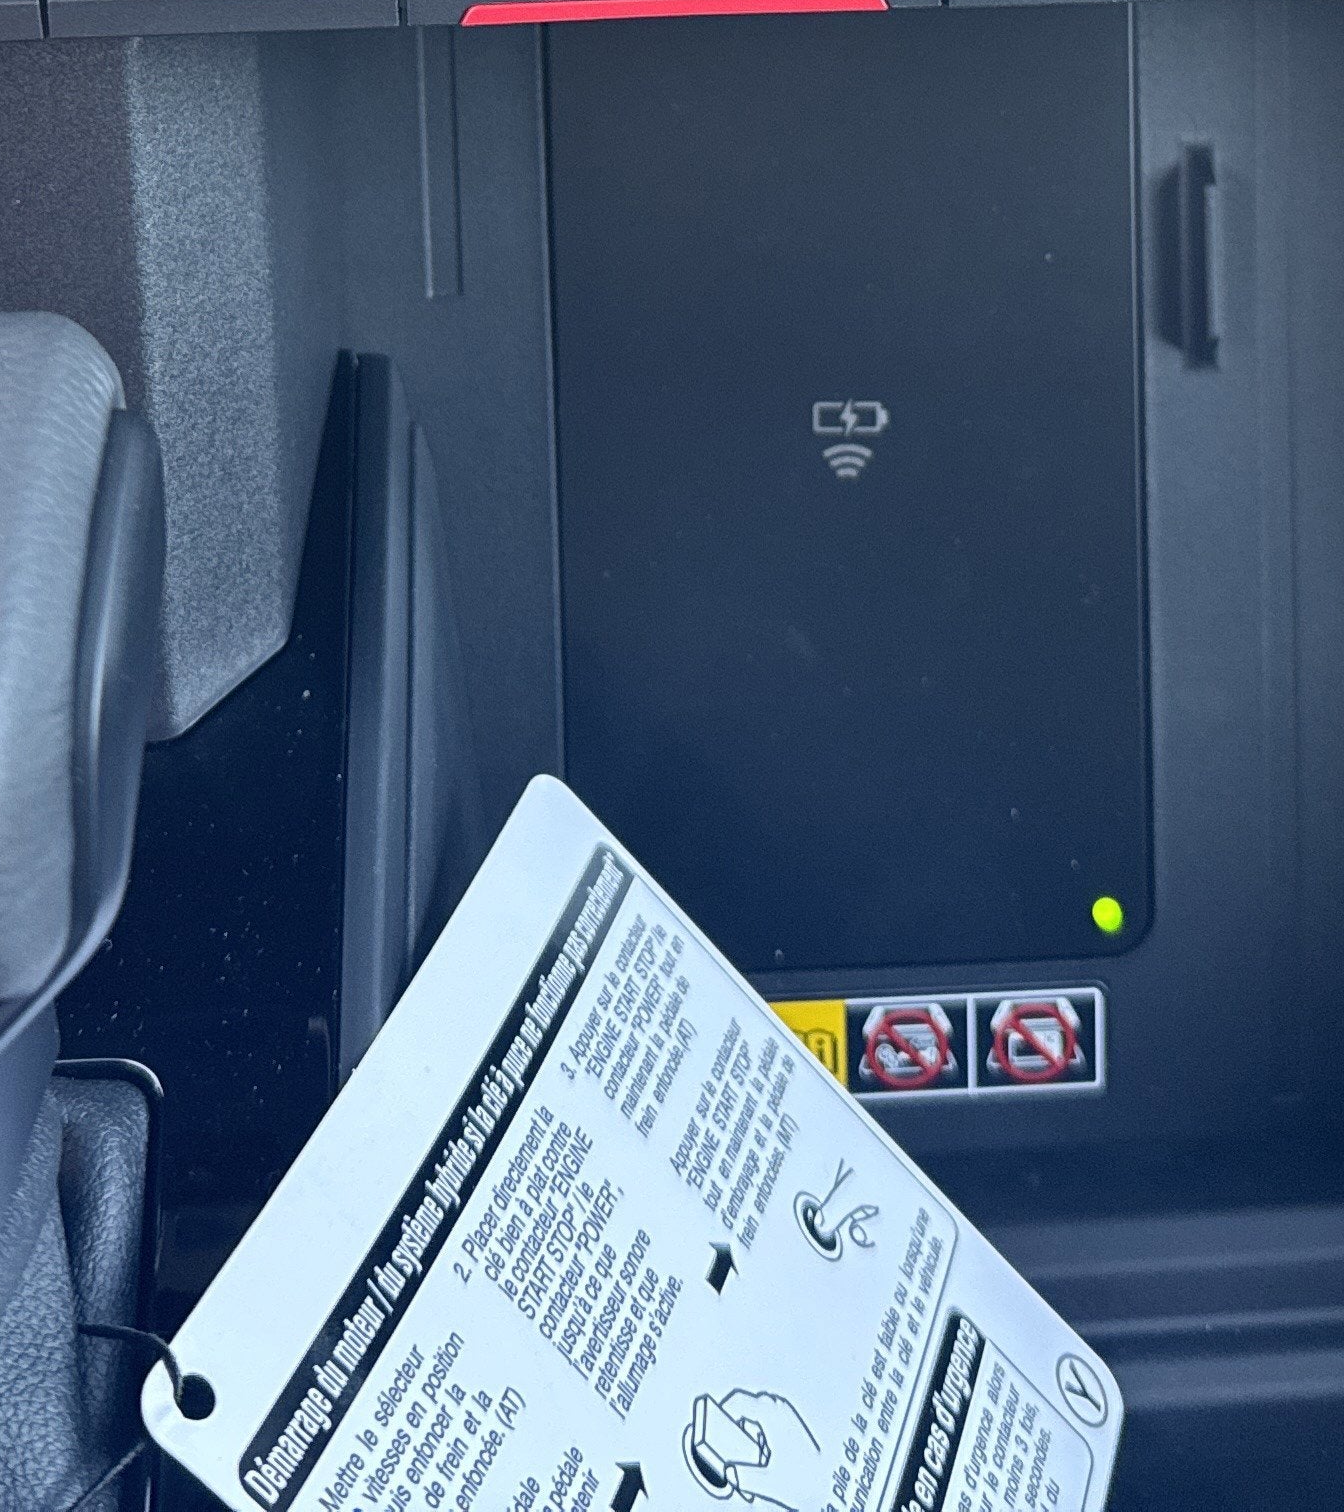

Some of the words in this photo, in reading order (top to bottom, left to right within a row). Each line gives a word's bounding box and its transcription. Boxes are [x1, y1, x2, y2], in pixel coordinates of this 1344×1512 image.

[562, 929, 588, 972] pas
[612, 973, 641, 1024] START
[519, 1016, 543, 1047] ne
[501, 1034, 533, 1089] puce
[466, 1104, 495, 1134] la
[480, 1074, 508, 1119] clé
[533, 1104, 554, 1127] la
[461, 1114, 486, 1153] si
[541, 1121, 572, 1172] contre
[424, 1137, 477, 1210] hybride
[490, 1116, 547, 1211] directement
[525, 1163, 554, 1207] plat
[514, 1196, 534, 1218] à
[390, 1194, 444, 1277] système
[460, 1202, 501, 1264] Placer
[493, 1213, 526, 1256] bien
[496, 1278, 519, 1302] le
[510, 1195, 559, 1283] contacteur
[516, 1253, 556, 1321] START
[574, 1180, 594, 1202] le
[373, 1261, 406, 1300] du
[452, 1261, 472, 1284] 2.
[483, 1246, 506, 1282] clé
[637, 1266, 659, 1303] que
[538, 1251, 586, 1340] contacteur
[551, 1294, 593, 1366] jusqu'à
[583, 1274, 602, 1301] ce
[593, 1242, 617, 1279] que
[571, 1278, 627, 1382] l'avertisseur
[618, 1228, 651, 1287] sonore
[629, 1294, 647, 1321] et
[332, 1294, 385, 1374] moteur
[593, 1316, 638, 1401] retentisse
[312, 1359, 349, 1398] du
[470, 1389, 493, 1413] la
[607, 1332, 657, 1420] l'allumage
[1065, 1360, 1101, 1412] Y
[317, 1452, 365, 1512] Mettre
[354, 1428, 379, 1453] le
[373, 1342, 425, 1428] sélecteur
[360, 1427, 411, 1503] vitesses
[405, 1400, 427, 1429] en
[420, 1331, 465, 1405] position
[405, 1403, 454, 1485] enfoncer
[443, 1382, 467, 1406] la
[462, 1409, 482, 1435] et
[243, 1387, 333, 1505] Démarrage
[435, 1436, 469, 1482] frein
[454, 1428, 506, 1512] enfoncée.
[493, 1385, 526, 1431] (AT)
[923, 1422, 950, 1476] cas
[422, 1480, 445, 1509] de
[548, 1446, 583, 1512] pédale
[913, 1465, 938, 1508] en
